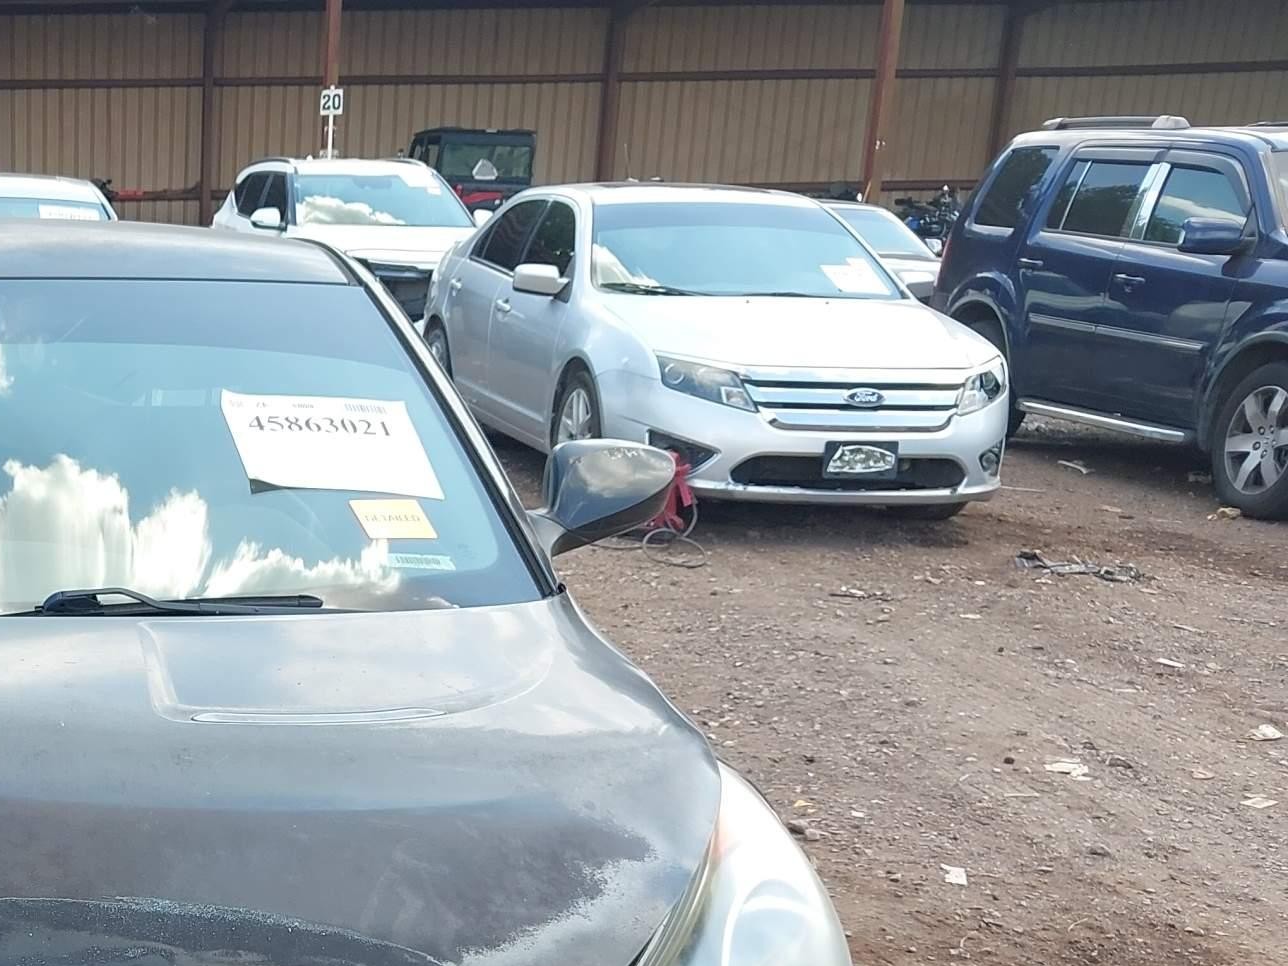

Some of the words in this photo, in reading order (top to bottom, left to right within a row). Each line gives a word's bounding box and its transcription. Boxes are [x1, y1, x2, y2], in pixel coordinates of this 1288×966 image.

[322, 93, 341, 110] 20
[854, 391, 879, 402] Ford
[248, 415, 391, 436] 45863021
